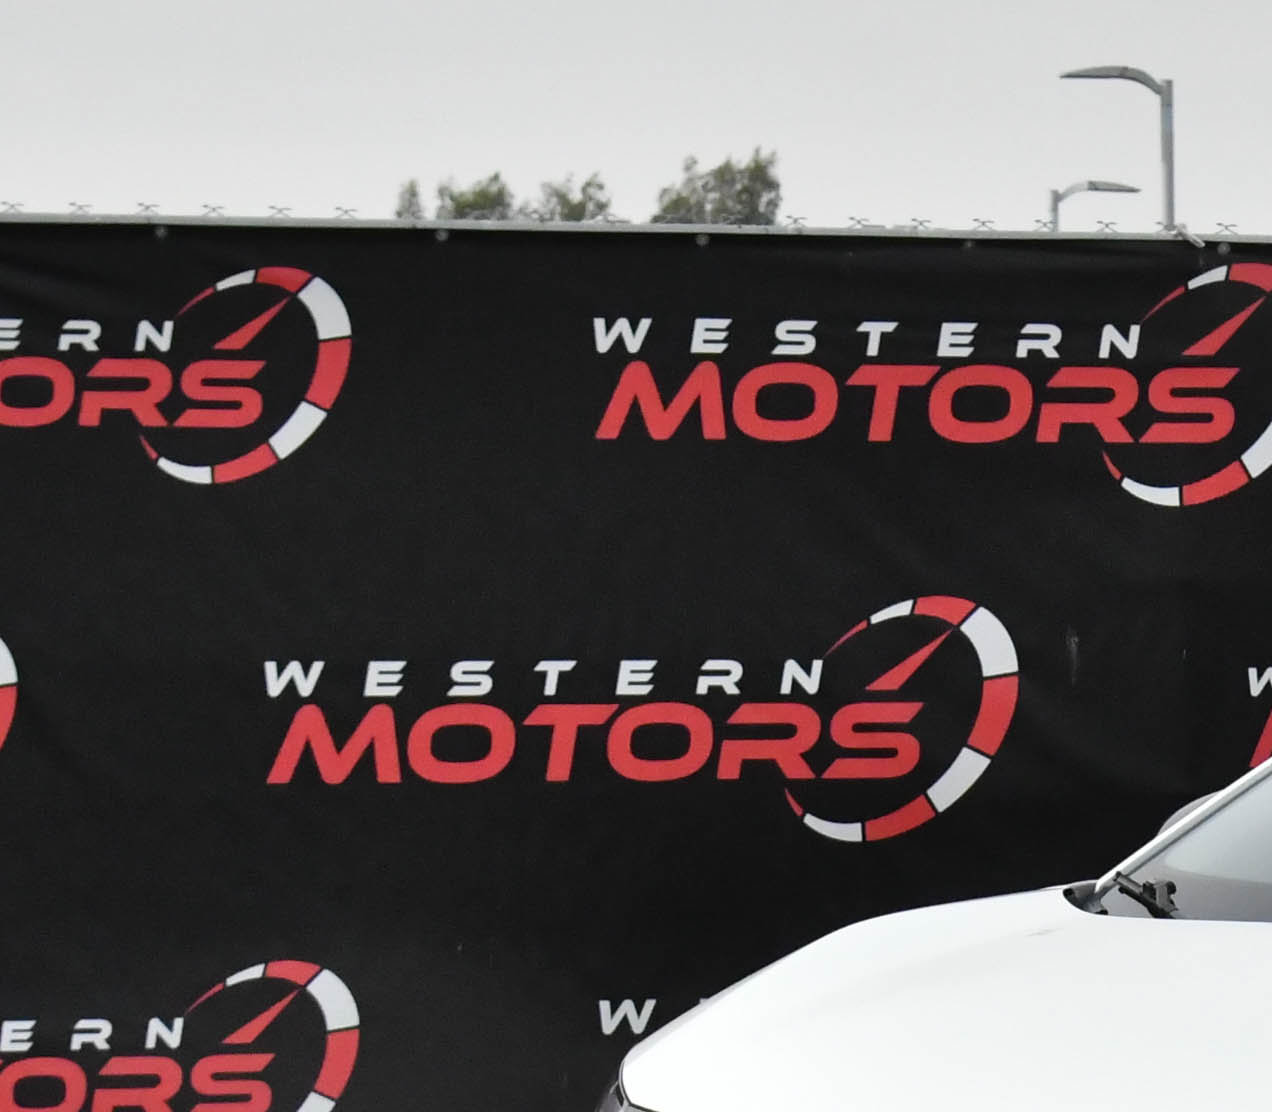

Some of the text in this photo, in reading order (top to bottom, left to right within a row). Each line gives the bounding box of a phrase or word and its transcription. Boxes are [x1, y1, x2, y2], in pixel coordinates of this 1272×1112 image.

[593, 317, 1141, 360] WESTERN
[595, 360, 1240, 444] MOTORS
[264, 659, 824, 698] WESTERN
[266, 701, 924, 785] MOTORS
